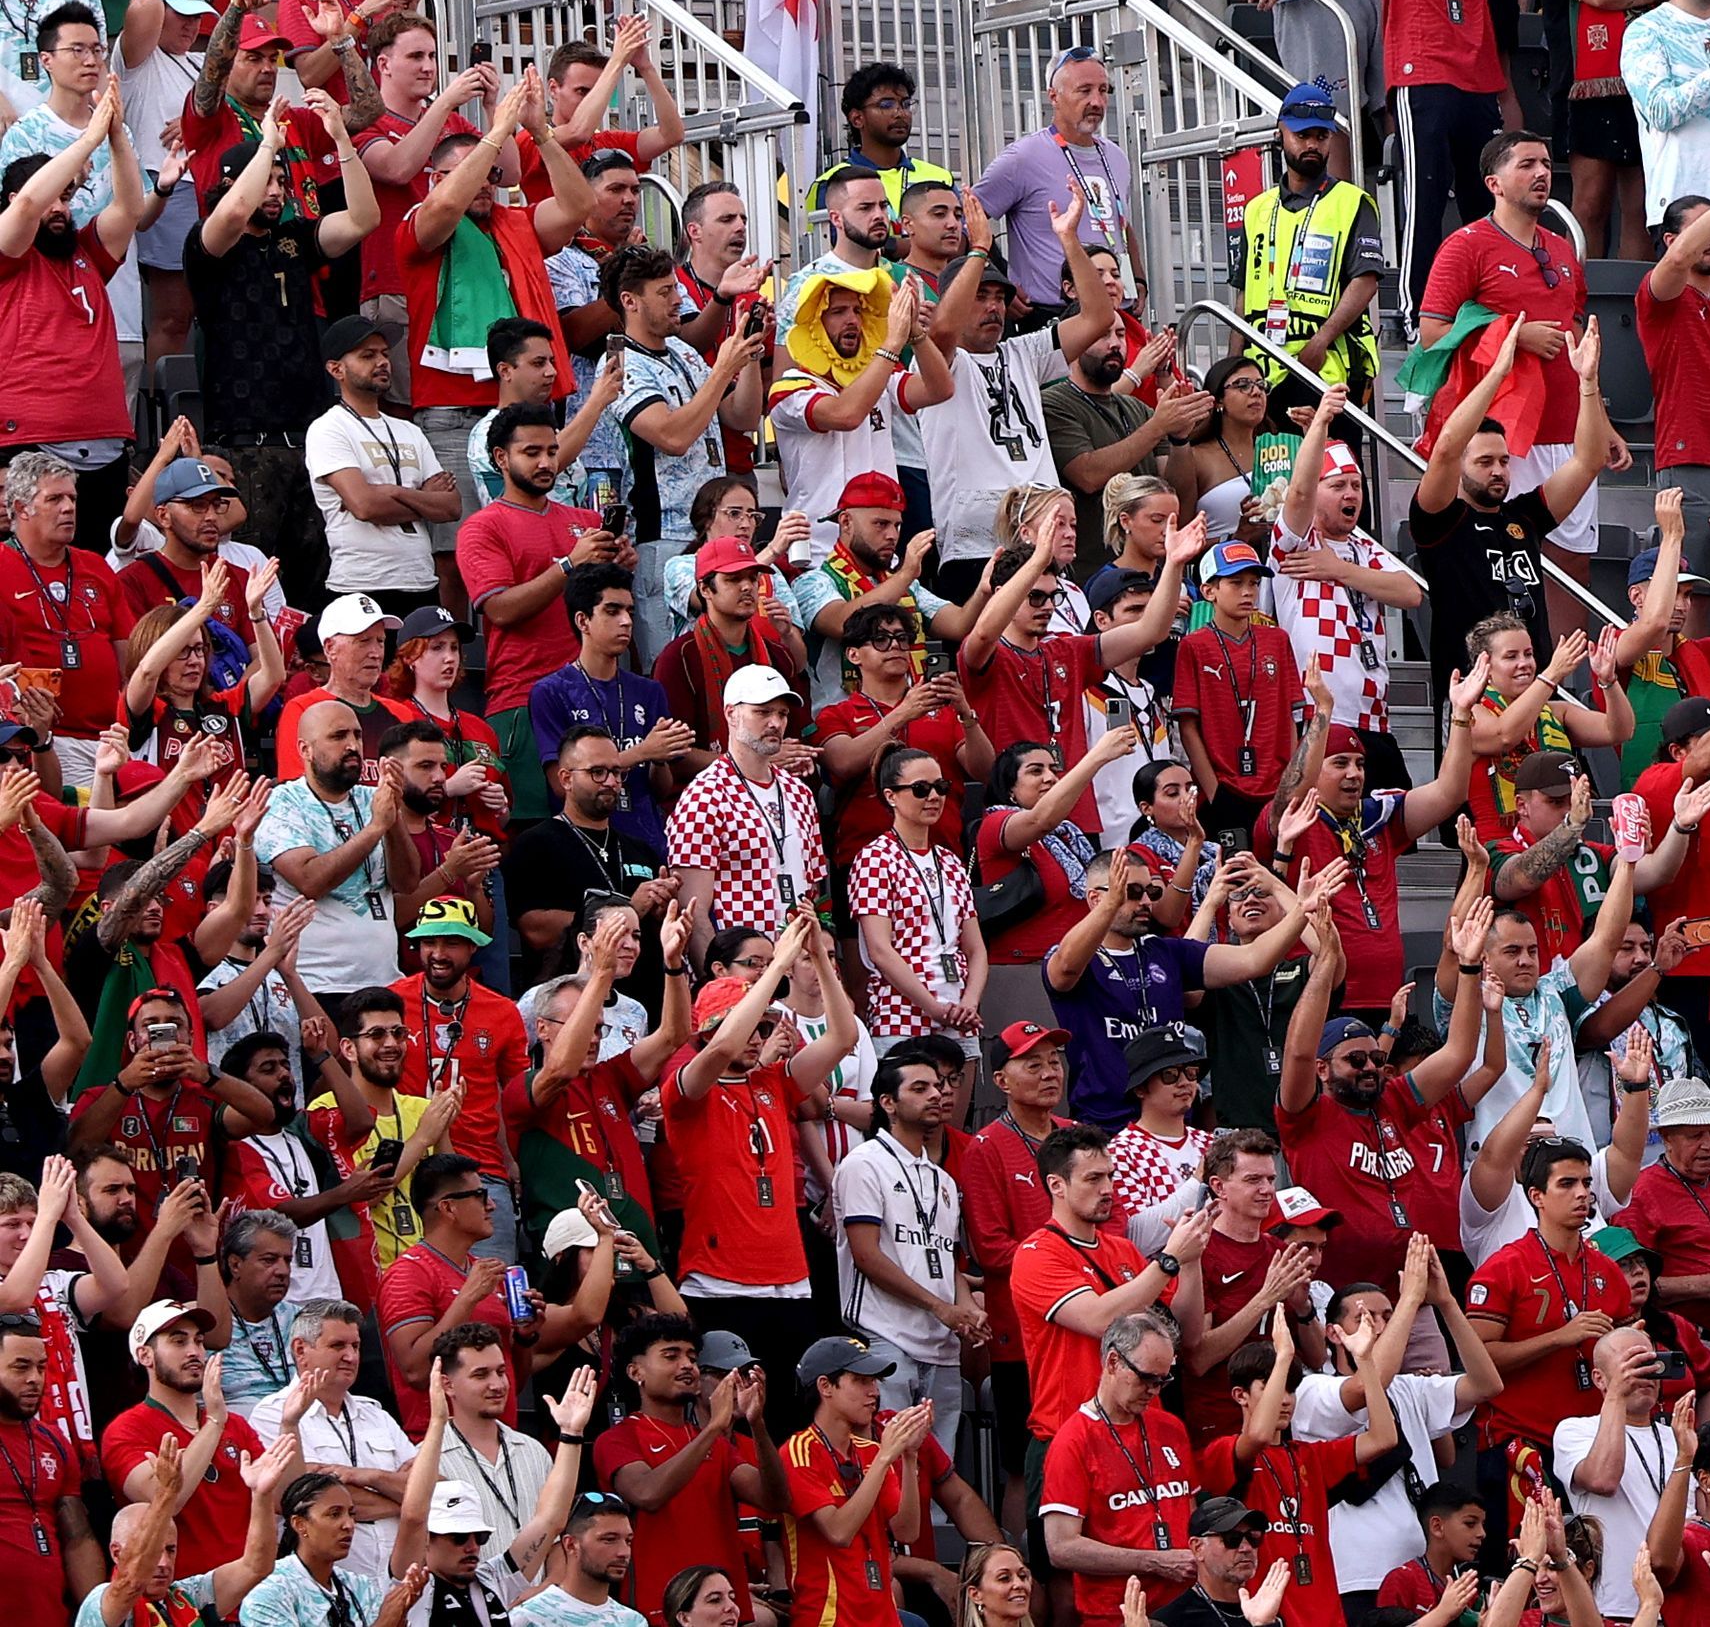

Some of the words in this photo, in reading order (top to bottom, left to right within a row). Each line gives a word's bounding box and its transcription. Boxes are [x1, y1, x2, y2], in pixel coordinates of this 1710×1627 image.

[1227, 193, 1245, 205] Section
[1226, 206, 1244, 224] 233
[274, 272, 288, 307] 7
[71, 285, 95, 325] 7
[1260, 445, 1289, 466] POP
[197, 464, 211, 482] P
[1263, 459, 1291, 474] CORN
[436, 607, 454, 622] NY
[571, 709, 589, 721] Y-3
[569, 1121, 597, 1157] 15
[1428, 1142, 1443, 1173] 7
[1534, 1288, 1551, 1325] 7
[1107, 1479, 1191, 1511] CANADA
